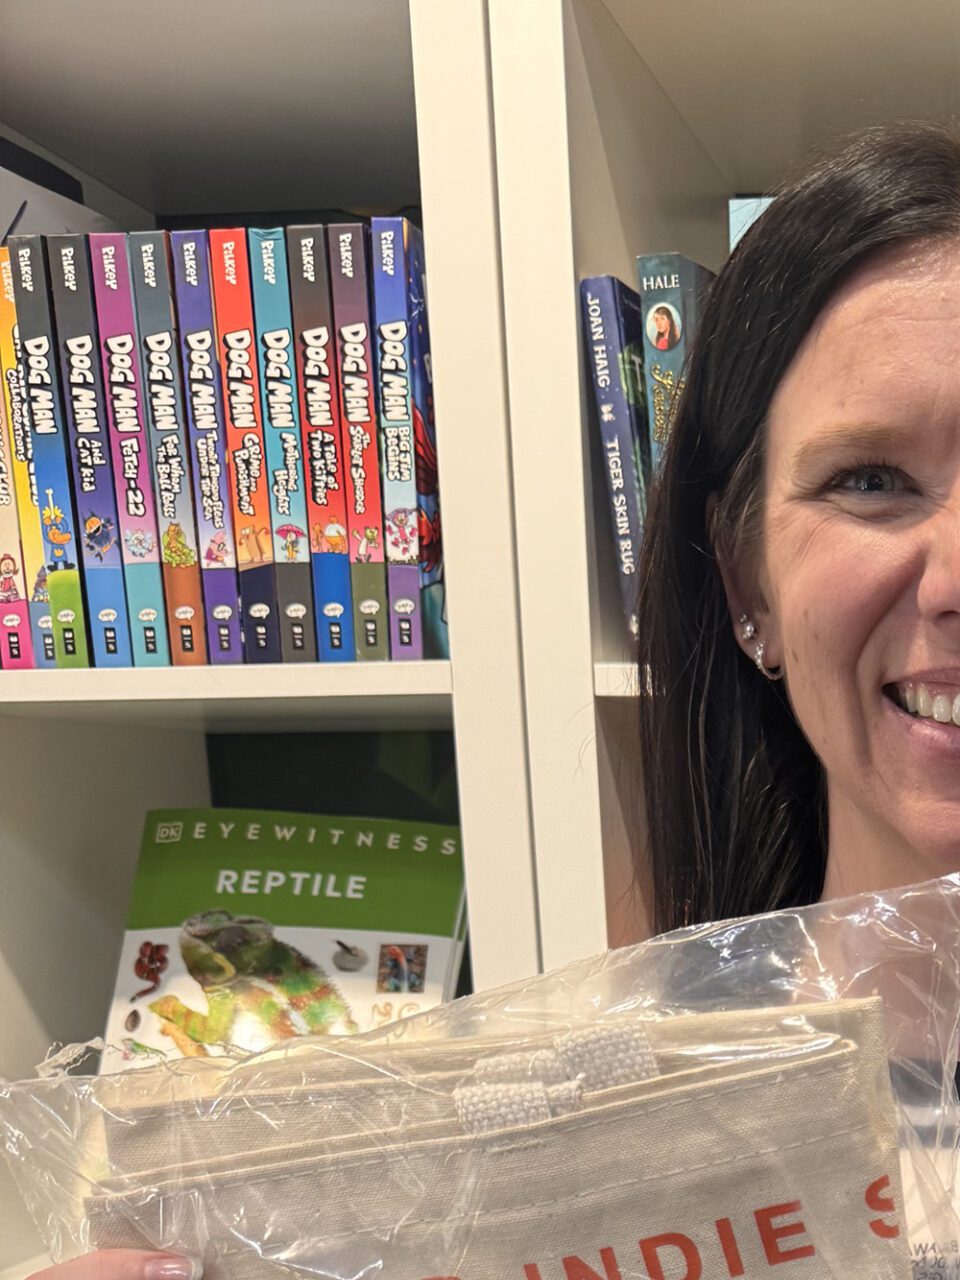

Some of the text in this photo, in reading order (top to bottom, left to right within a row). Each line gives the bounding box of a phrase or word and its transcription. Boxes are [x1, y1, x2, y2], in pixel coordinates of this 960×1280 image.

[642, 274, 680, 290] HALE
[23, 335, 51, 384] DOG
[66, 335, 100, 433] DOG MAN
[106, 334, 141, 433] DOG MAN
[146, 331, 179, 430] DOG MAN
[186, 330, 218, 430] DOG MAN
[224, 329, 257, 429] DOG MAN
[263, 328, 296, 428] DOG MAN
[302, 326, 334, 426] DOG MAN
[340, 322, 372, 423] DOG MAN
[379, 320, 410, 421] DOG MAN
[29, 387, 58, 434] MAN
[587, 293, 636, 576] JOAN HAIG TIGER SKIN RUG
[159, 823, 456, 855] DK EYEWITNESS
[215, 869, 367, 899] REPTILE
